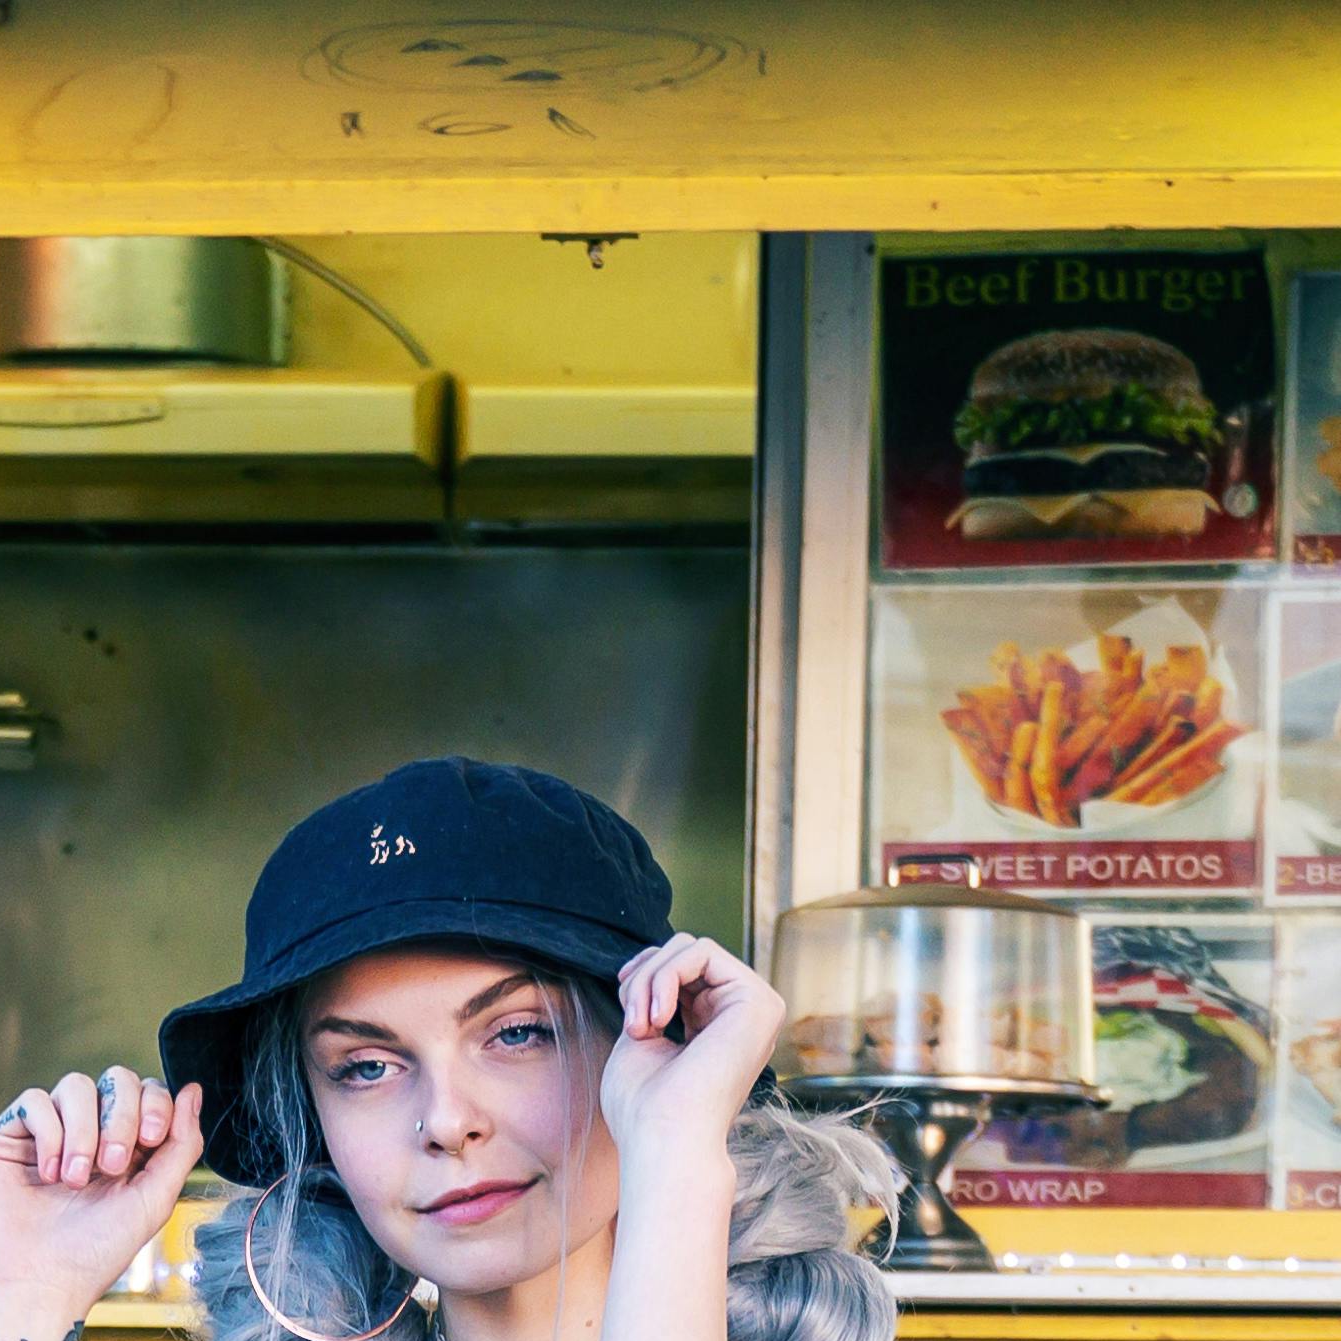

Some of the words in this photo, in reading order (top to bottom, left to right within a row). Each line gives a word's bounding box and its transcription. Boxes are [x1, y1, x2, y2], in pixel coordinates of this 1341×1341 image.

[904, 260, 1038, 308] Beef
[1055, 260, 1258, 313] Burger
[939, 854, 1057, 884] SWEET
[1064, 853, 1224, 883] POTATOS
[1007, 1179, 1107, 1202] WRAP
